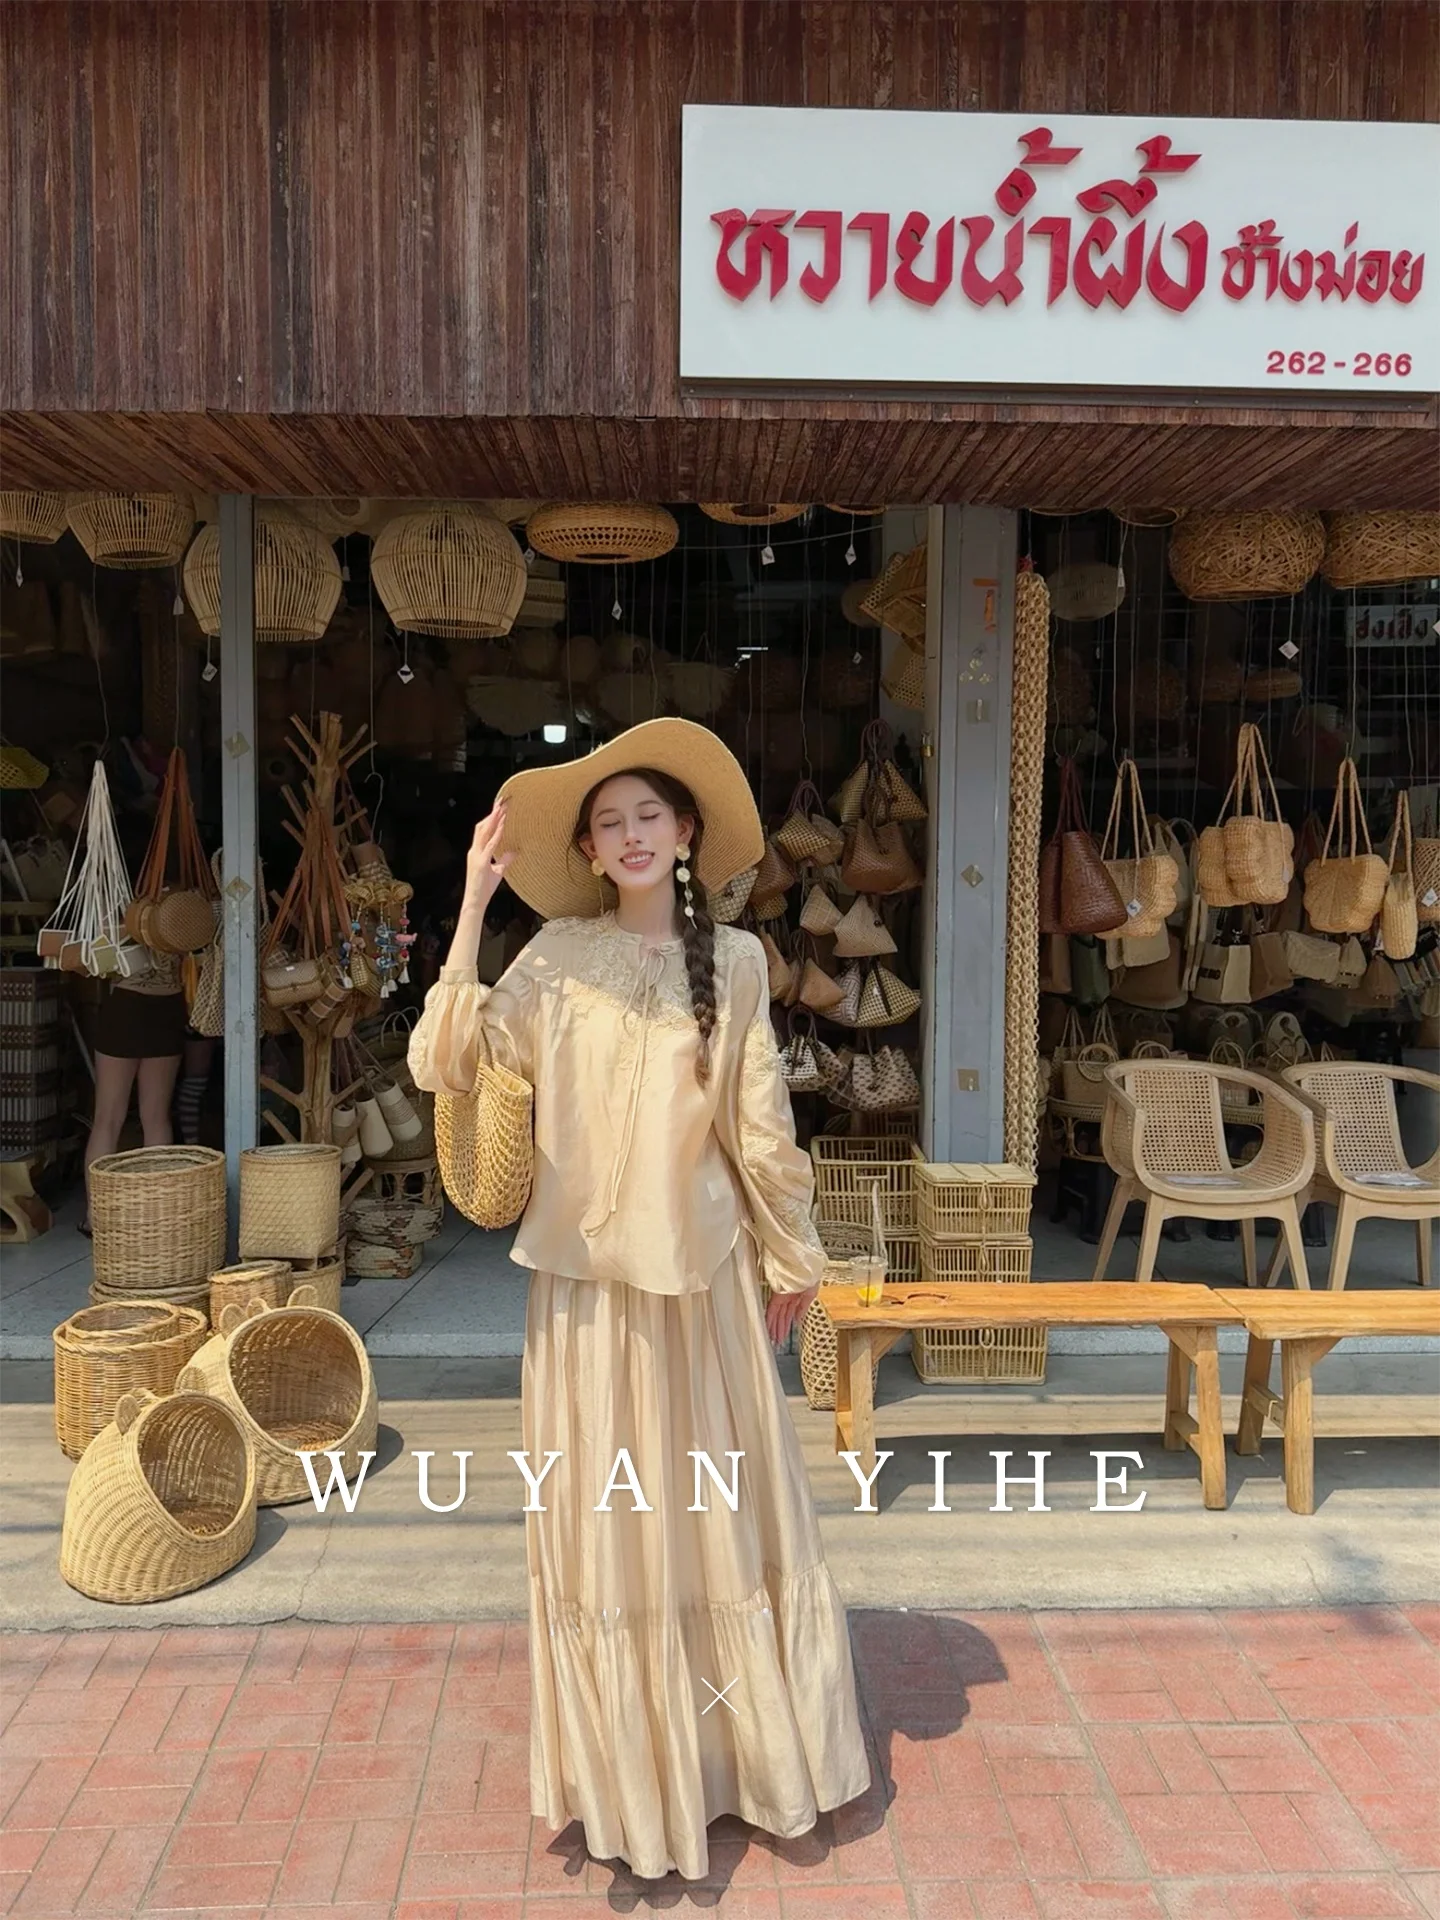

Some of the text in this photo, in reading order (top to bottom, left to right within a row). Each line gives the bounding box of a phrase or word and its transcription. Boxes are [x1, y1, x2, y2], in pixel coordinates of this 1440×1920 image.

[710, 126, 1425, 313] หวายน้ำผึ้ง ช้างม่อย
